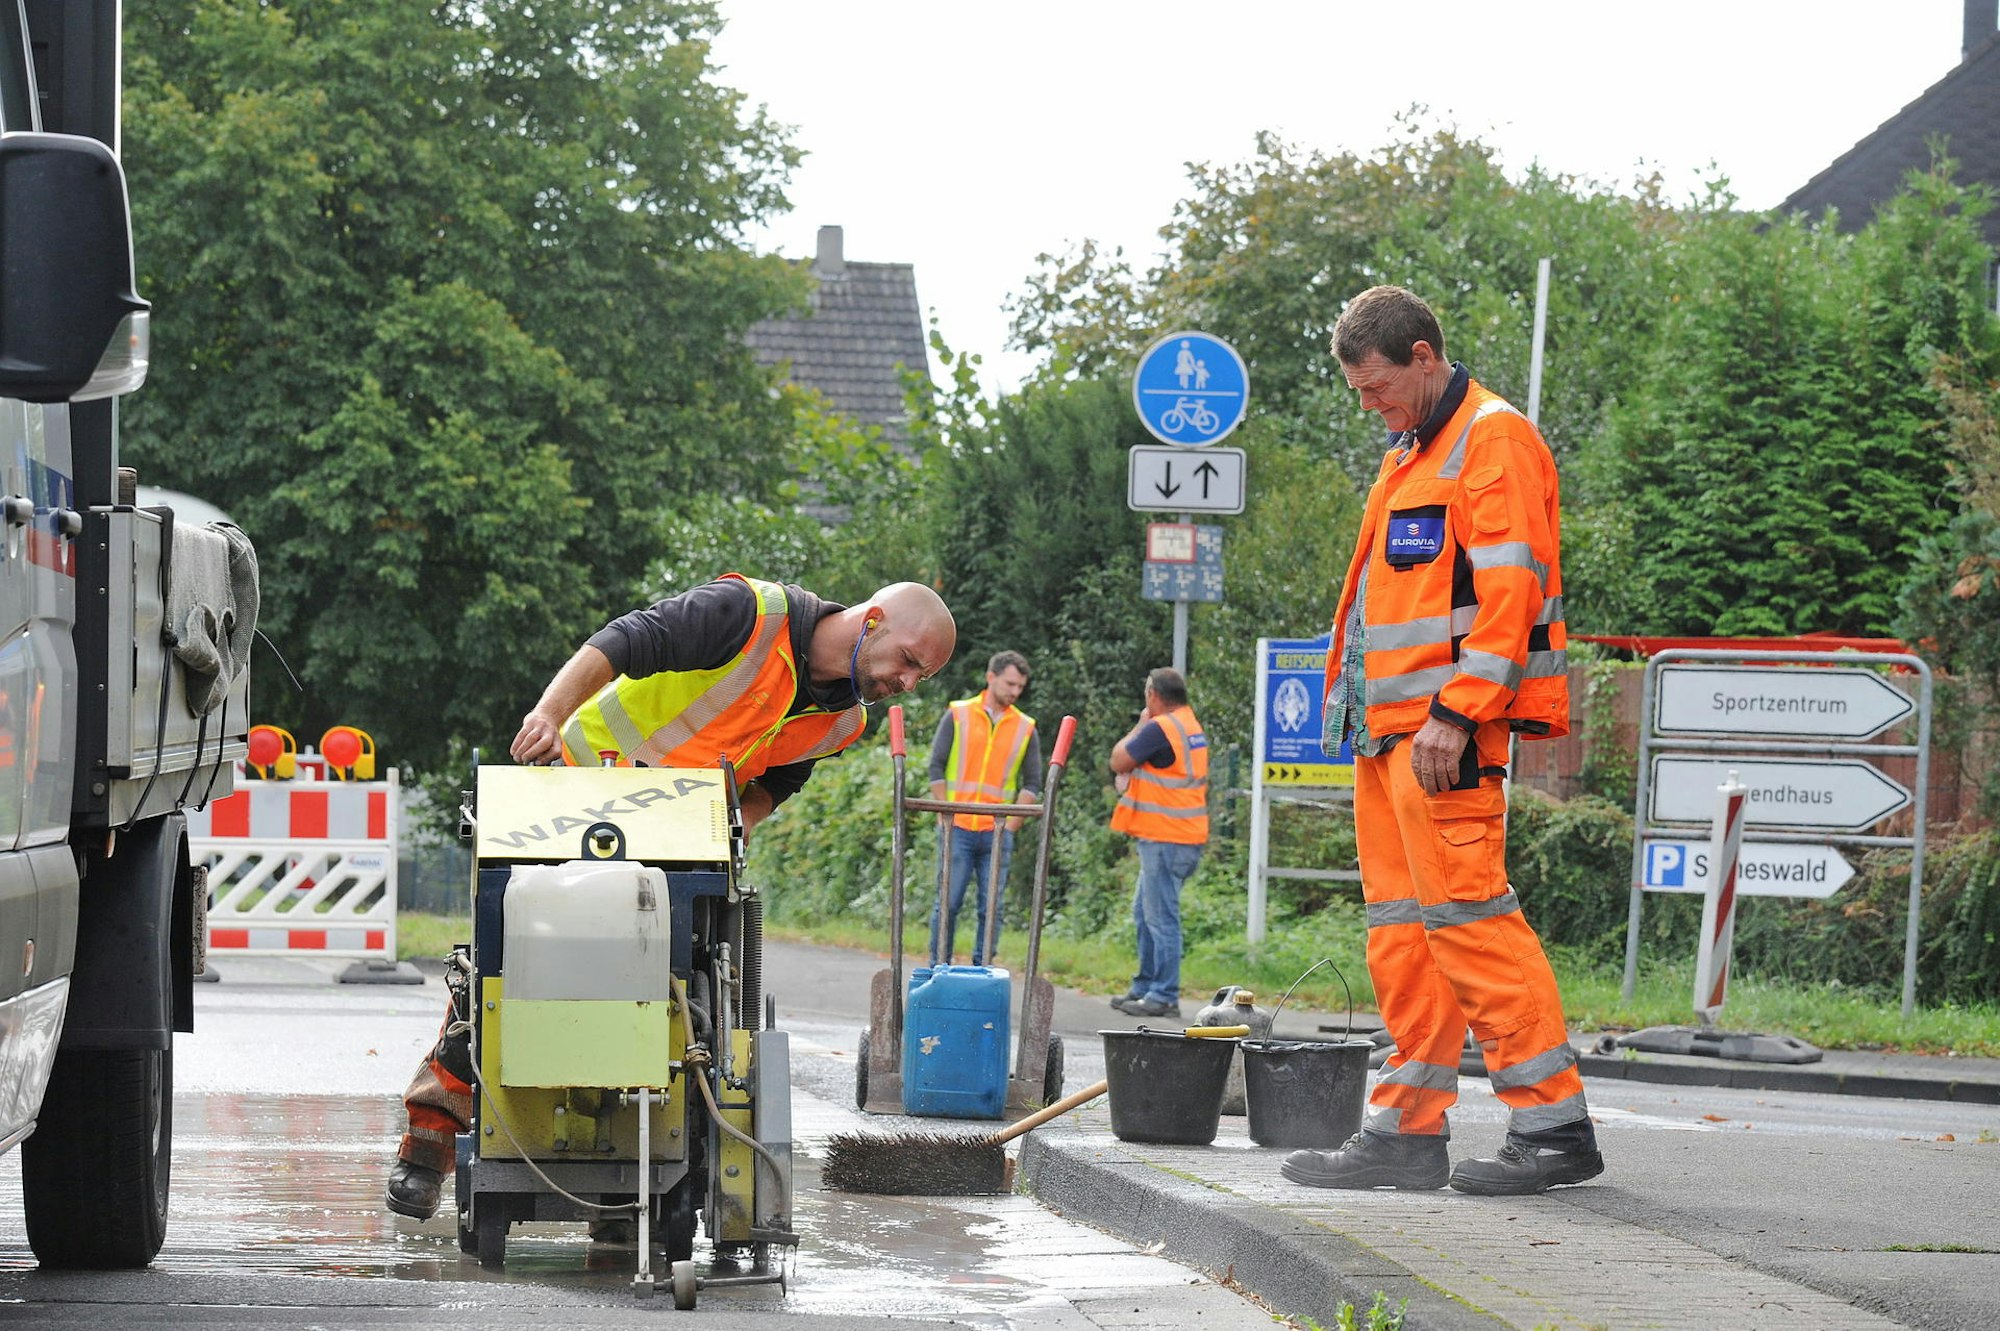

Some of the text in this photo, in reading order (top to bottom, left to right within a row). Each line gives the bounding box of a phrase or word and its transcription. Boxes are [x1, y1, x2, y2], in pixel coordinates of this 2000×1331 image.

[1392, 538, 1435, 546] EUROVIA
[1712, 692, 1847, 715] Sportzentrum
[486, 777, 719, 849] WAKRA
[1651, 845, 1680, 885] P
